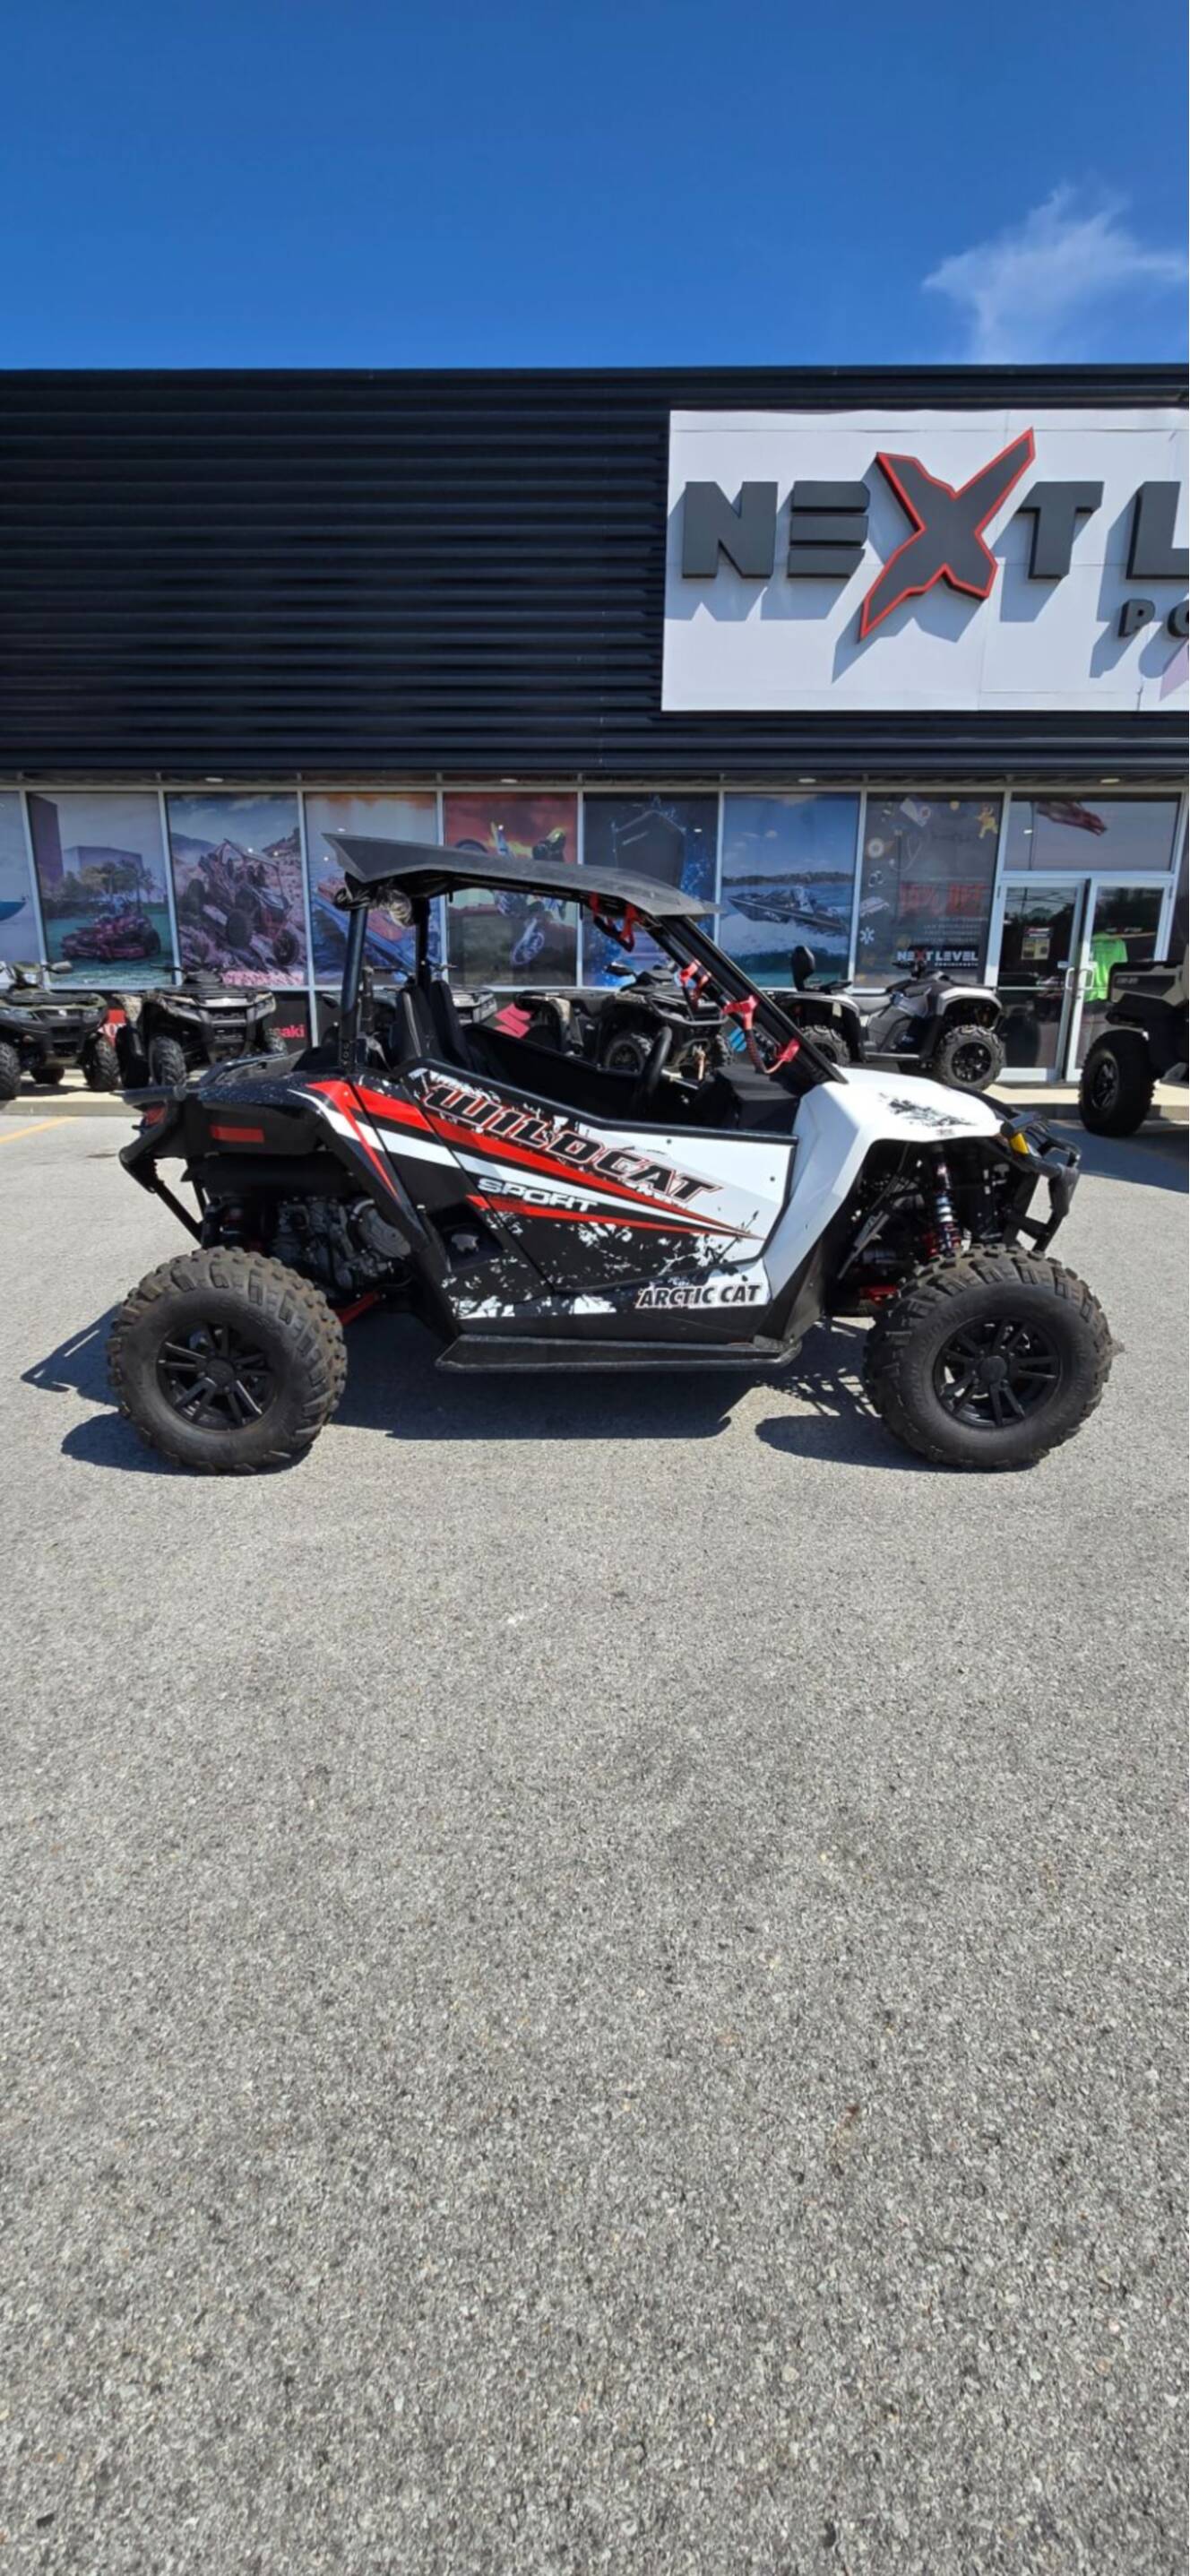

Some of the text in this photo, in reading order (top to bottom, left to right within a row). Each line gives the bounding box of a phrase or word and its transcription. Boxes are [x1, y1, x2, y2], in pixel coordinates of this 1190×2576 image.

[681, 427, 1105, 643] NEXT
[897, 947, 979, 963] NEXT LEVEL
[422, 1084, 723, 1203] WILDCAT
[477, 1177, 598, 1212] SPORT
[637, 1284, 761, 1307] ARCTIC CAT
